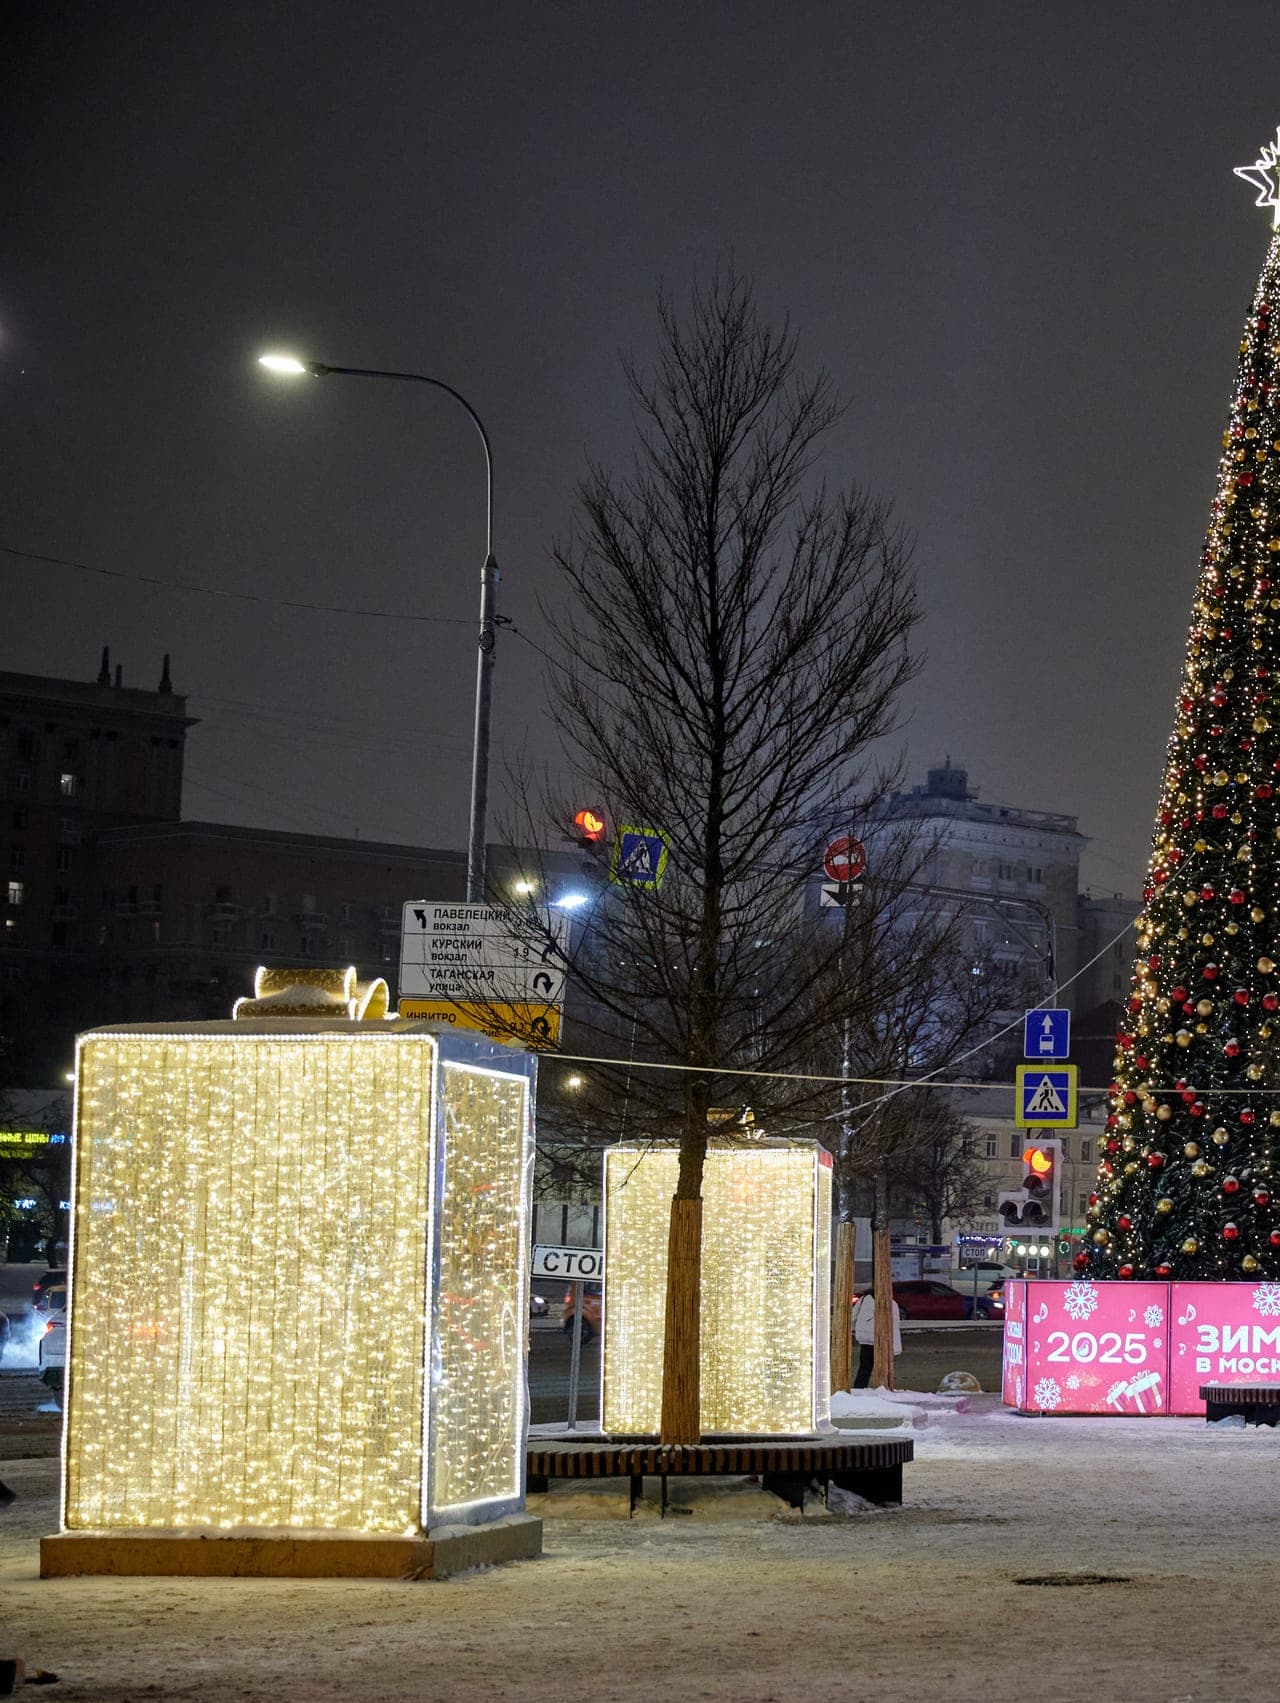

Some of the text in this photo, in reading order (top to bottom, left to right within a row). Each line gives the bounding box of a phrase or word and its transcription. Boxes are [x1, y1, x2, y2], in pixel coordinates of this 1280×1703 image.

[434, 908, 510, 921] ПАВЕЛЕЦКИЙ
[433, 922, 470, 931] вокзал
[432, 938, 482, 949] КУРСКИЙ
[431, 952, 467, 961] вокзал
[514, 947, 529, 957] 1.9
[430, 969, 494, 980] ТАГАНСКАЯ
[429, 981, 461, 992] улица
[966, 1248, 985, 1257] СТОП
[1047, 1331, 1147, 1364] 2025
[1196, 1357, 1211, 1373] В
